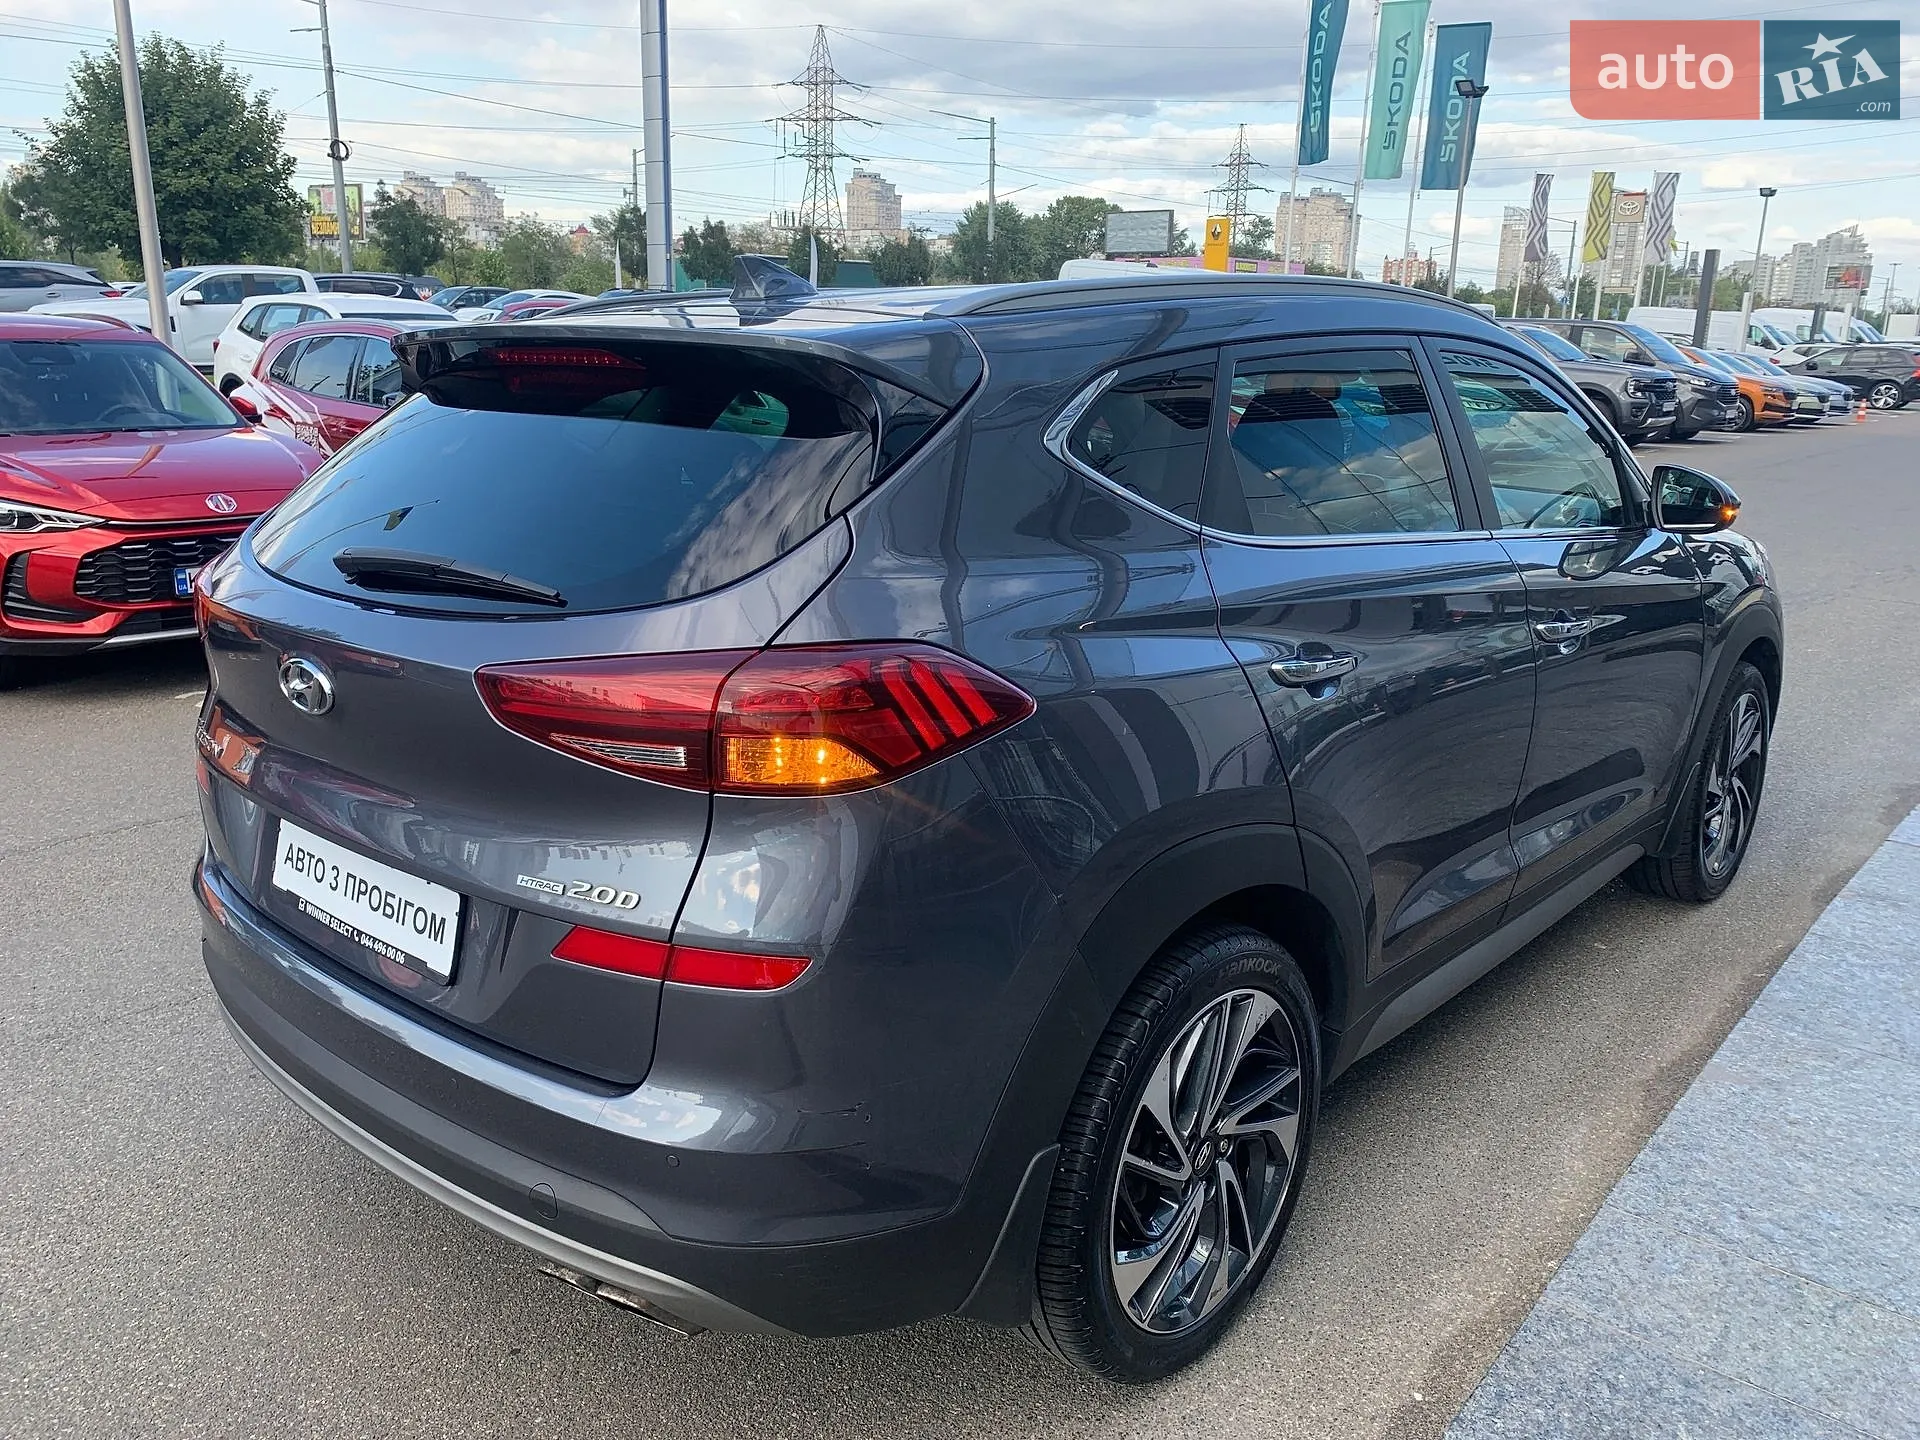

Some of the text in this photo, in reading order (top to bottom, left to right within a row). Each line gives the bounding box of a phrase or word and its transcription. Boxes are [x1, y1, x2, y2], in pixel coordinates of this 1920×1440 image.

[1310, 2, 1332, 133] SKODA
[1382, 30, 1412, 150] SKODA
[284, 843, 326, 883] АВТО
[344, 872, 447, 945] ПРОБІГОМ
[519, 876, 561, 893] HTRAC
[305, 901, 353, 939] WINNER SELECT
[360, 933, 405, 964] 044 496 00 06
